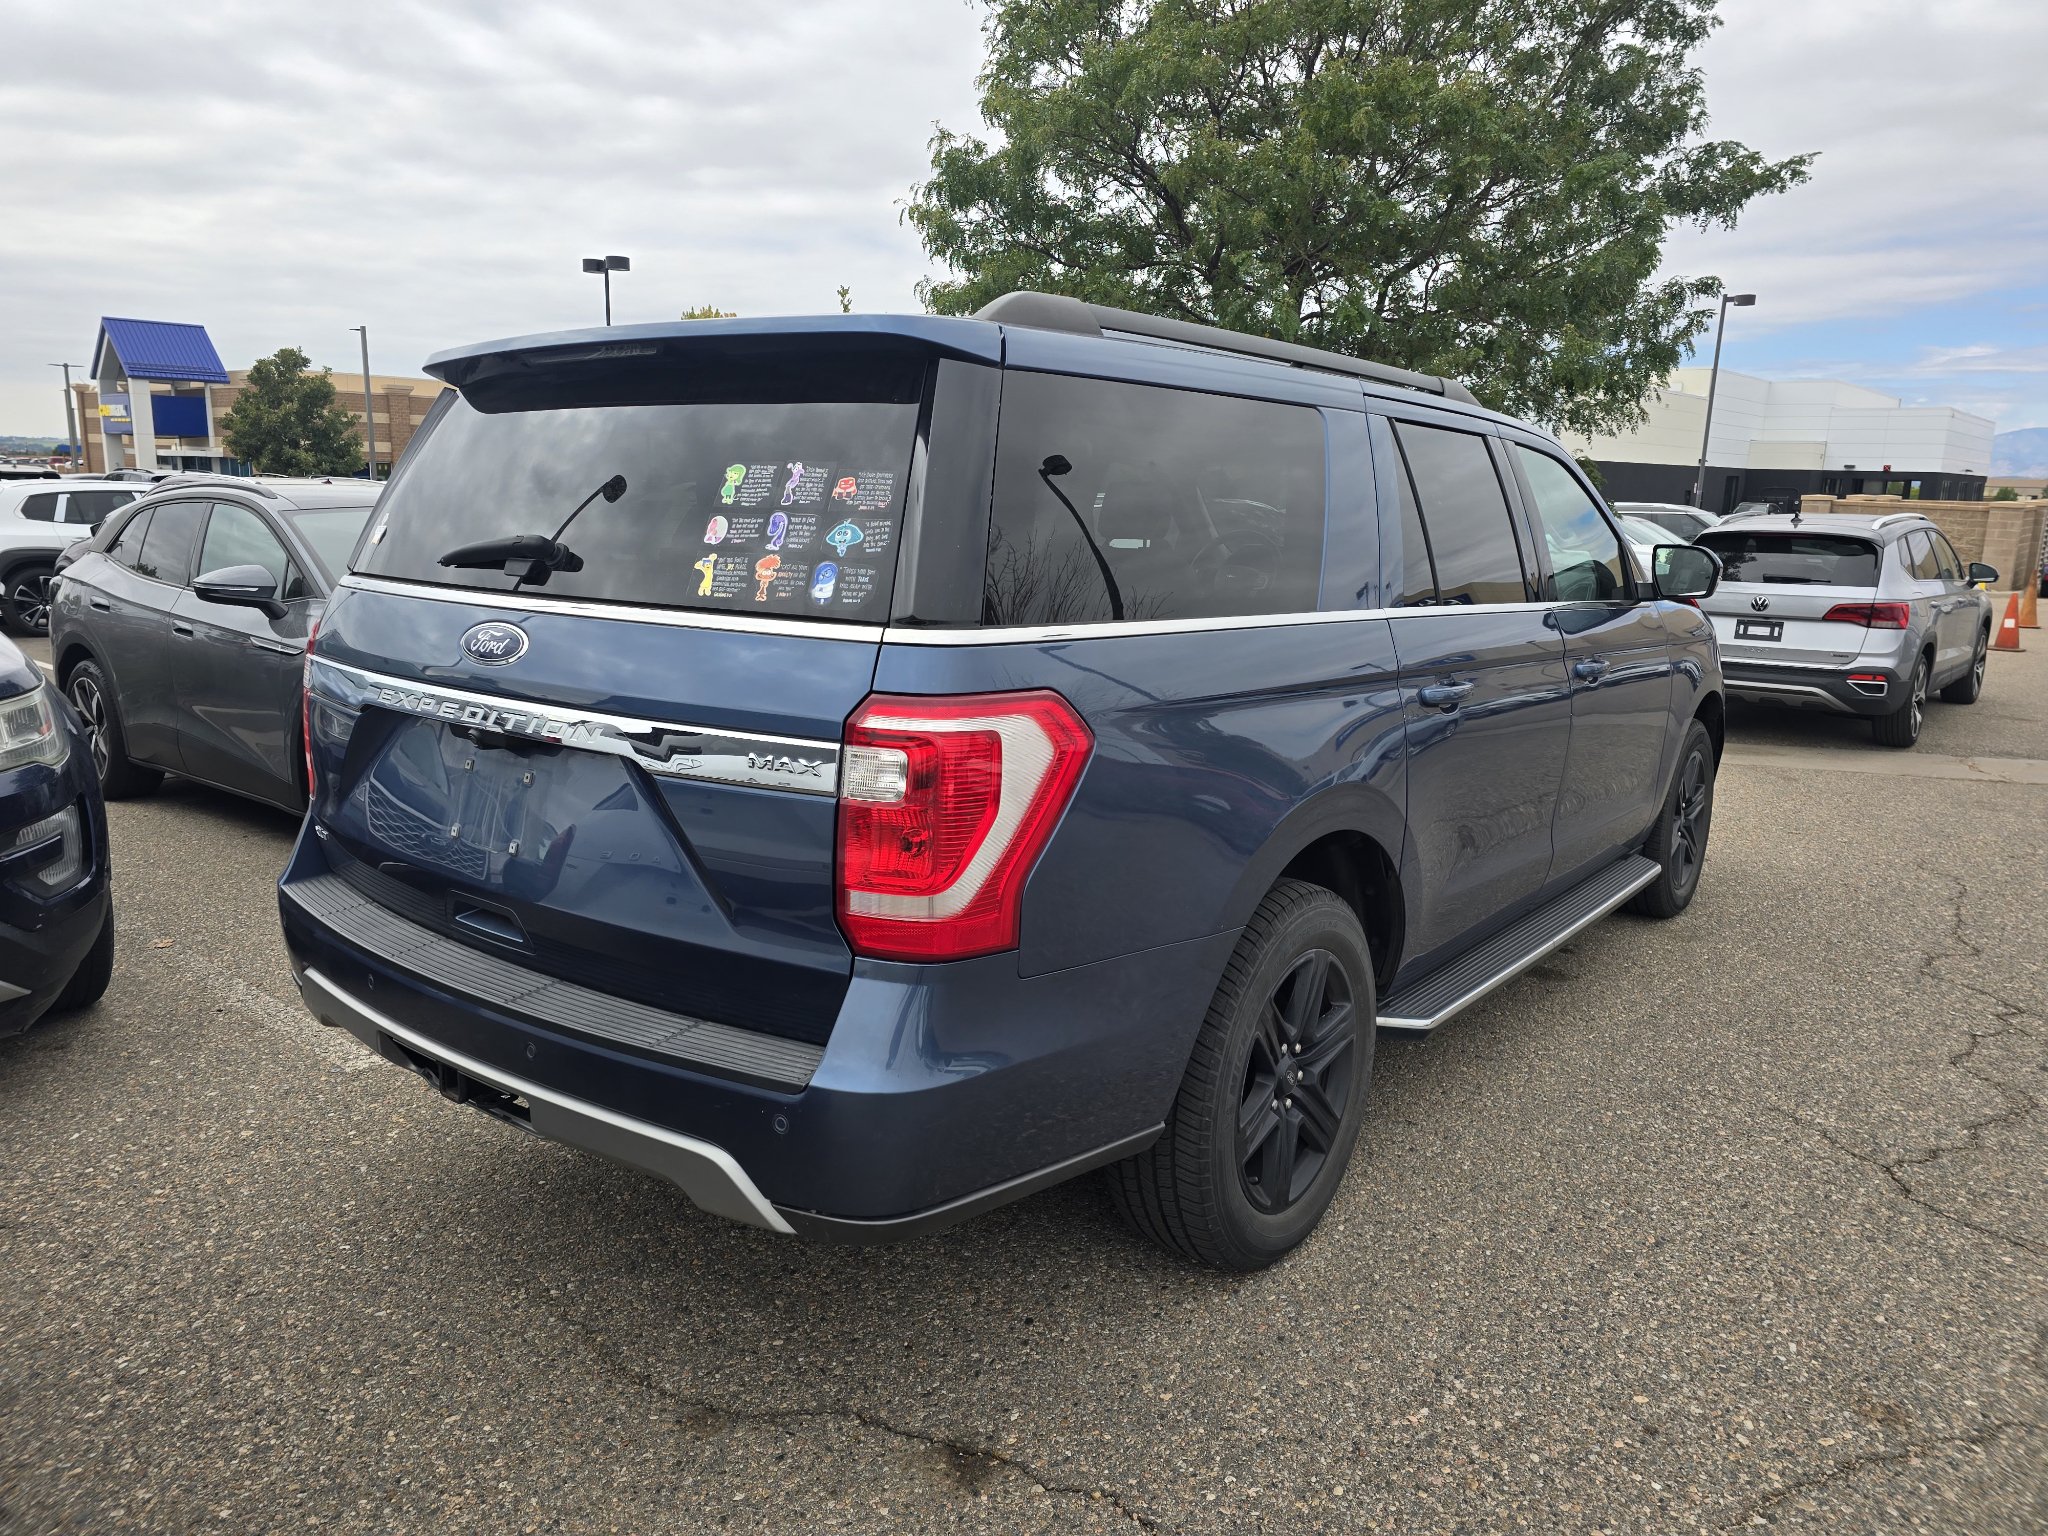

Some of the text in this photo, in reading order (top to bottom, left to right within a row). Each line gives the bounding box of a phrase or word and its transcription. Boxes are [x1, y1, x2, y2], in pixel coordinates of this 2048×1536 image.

[470, 629, 511, 655] Ford
[377, 687, 604, 744] EXPEDITION
[748, 752, 824, 778] MAX
